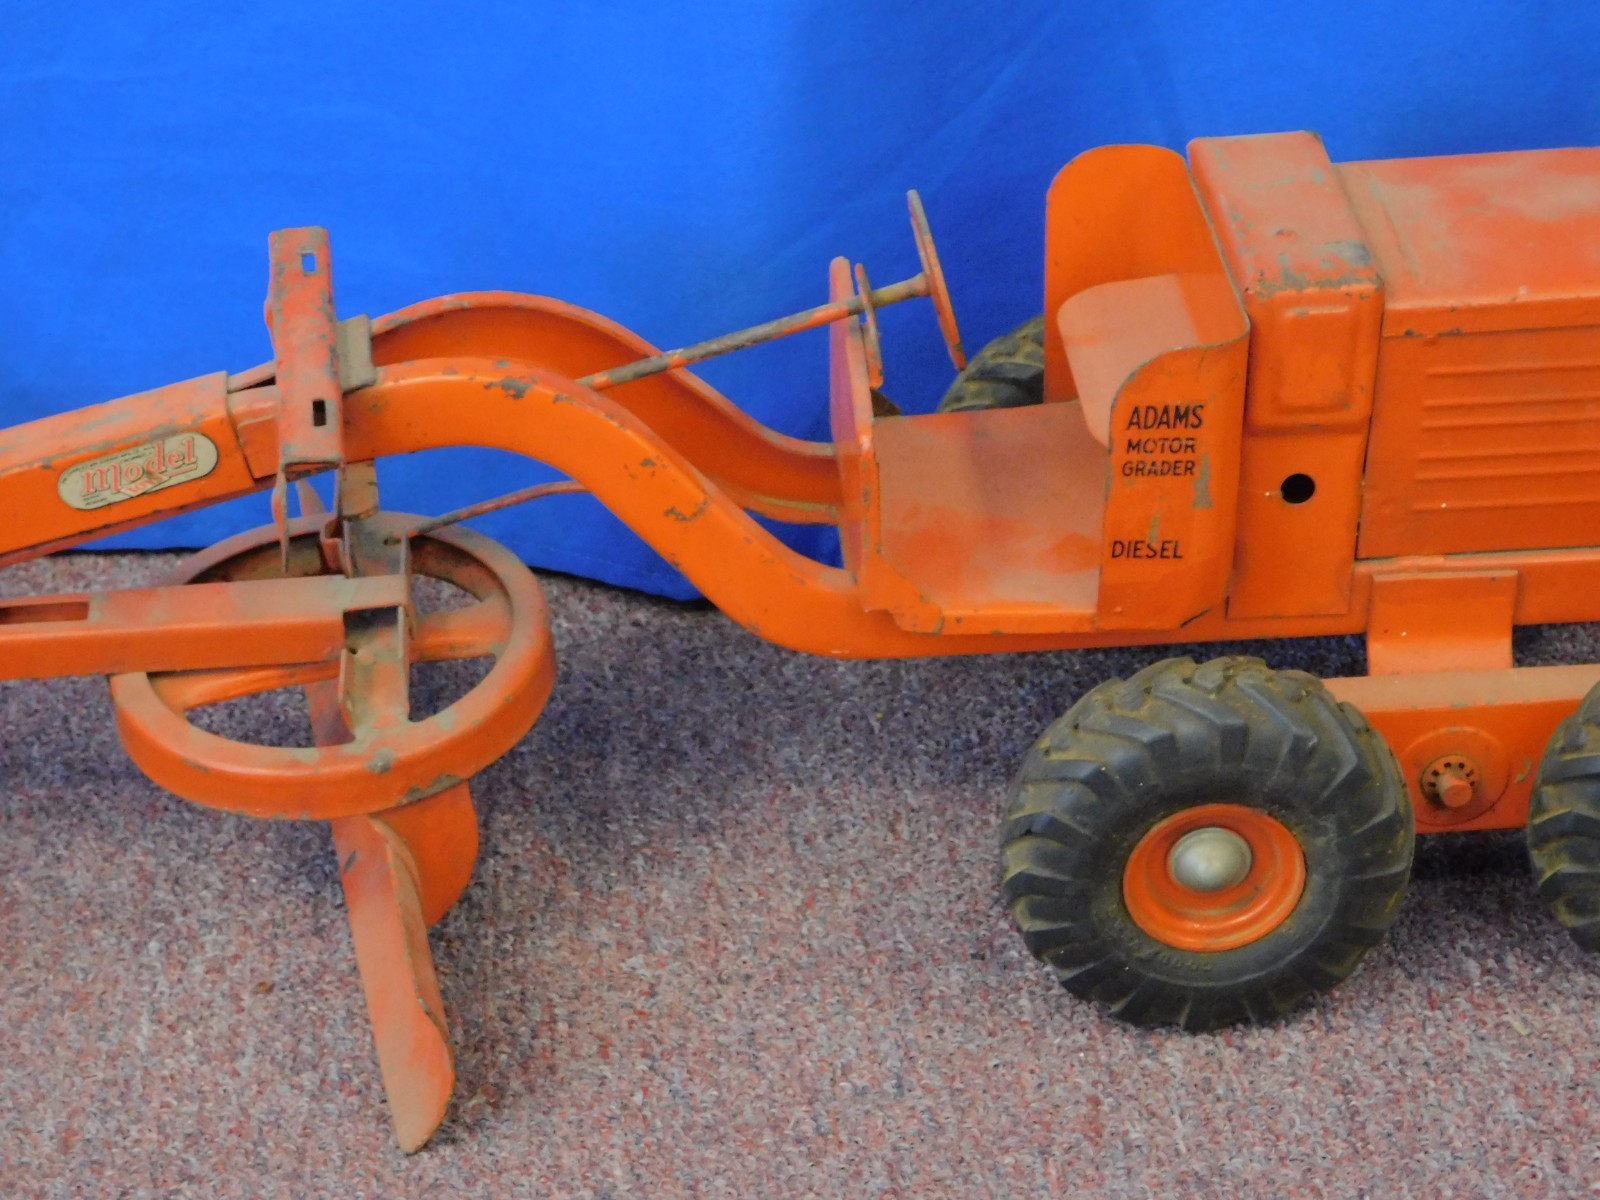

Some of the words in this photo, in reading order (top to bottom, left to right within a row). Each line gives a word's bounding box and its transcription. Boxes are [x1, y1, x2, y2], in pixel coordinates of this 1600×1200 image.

[1127, 404, 1204, 430] ADAMS
[1126, 437, 1197, 455] MOTOR
[1122, 460, 1196, 477] GRADER
[1111, 540, 1184, 559] DIESEL
